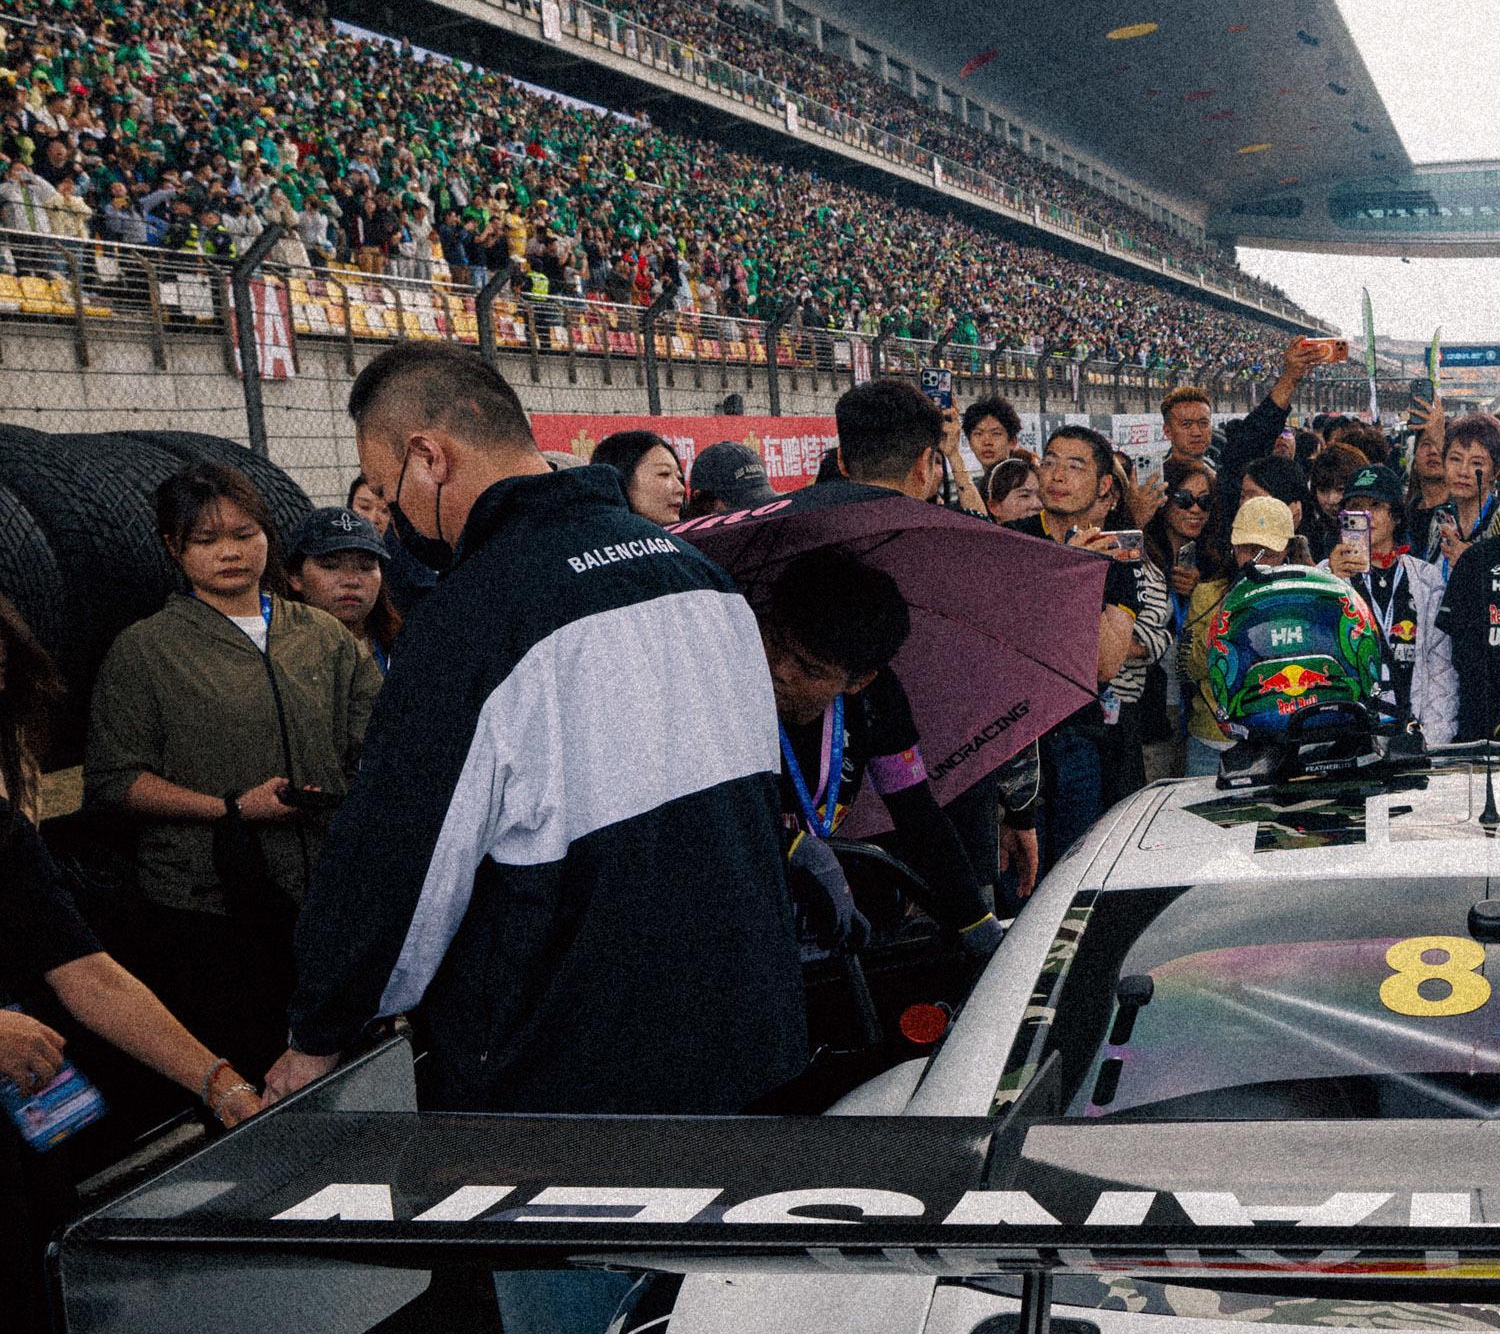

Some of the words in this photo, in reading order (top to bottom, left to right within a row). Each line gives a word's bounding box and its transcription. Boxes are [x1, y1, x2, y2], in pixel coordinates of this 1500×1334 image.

[567, 537, 681, 574] BALENCIAGA
[1270, 625, 1304, 648] HH
[1277, 697, 1297, 716] Red
[928, 700, 1030, 781] UNORACING
